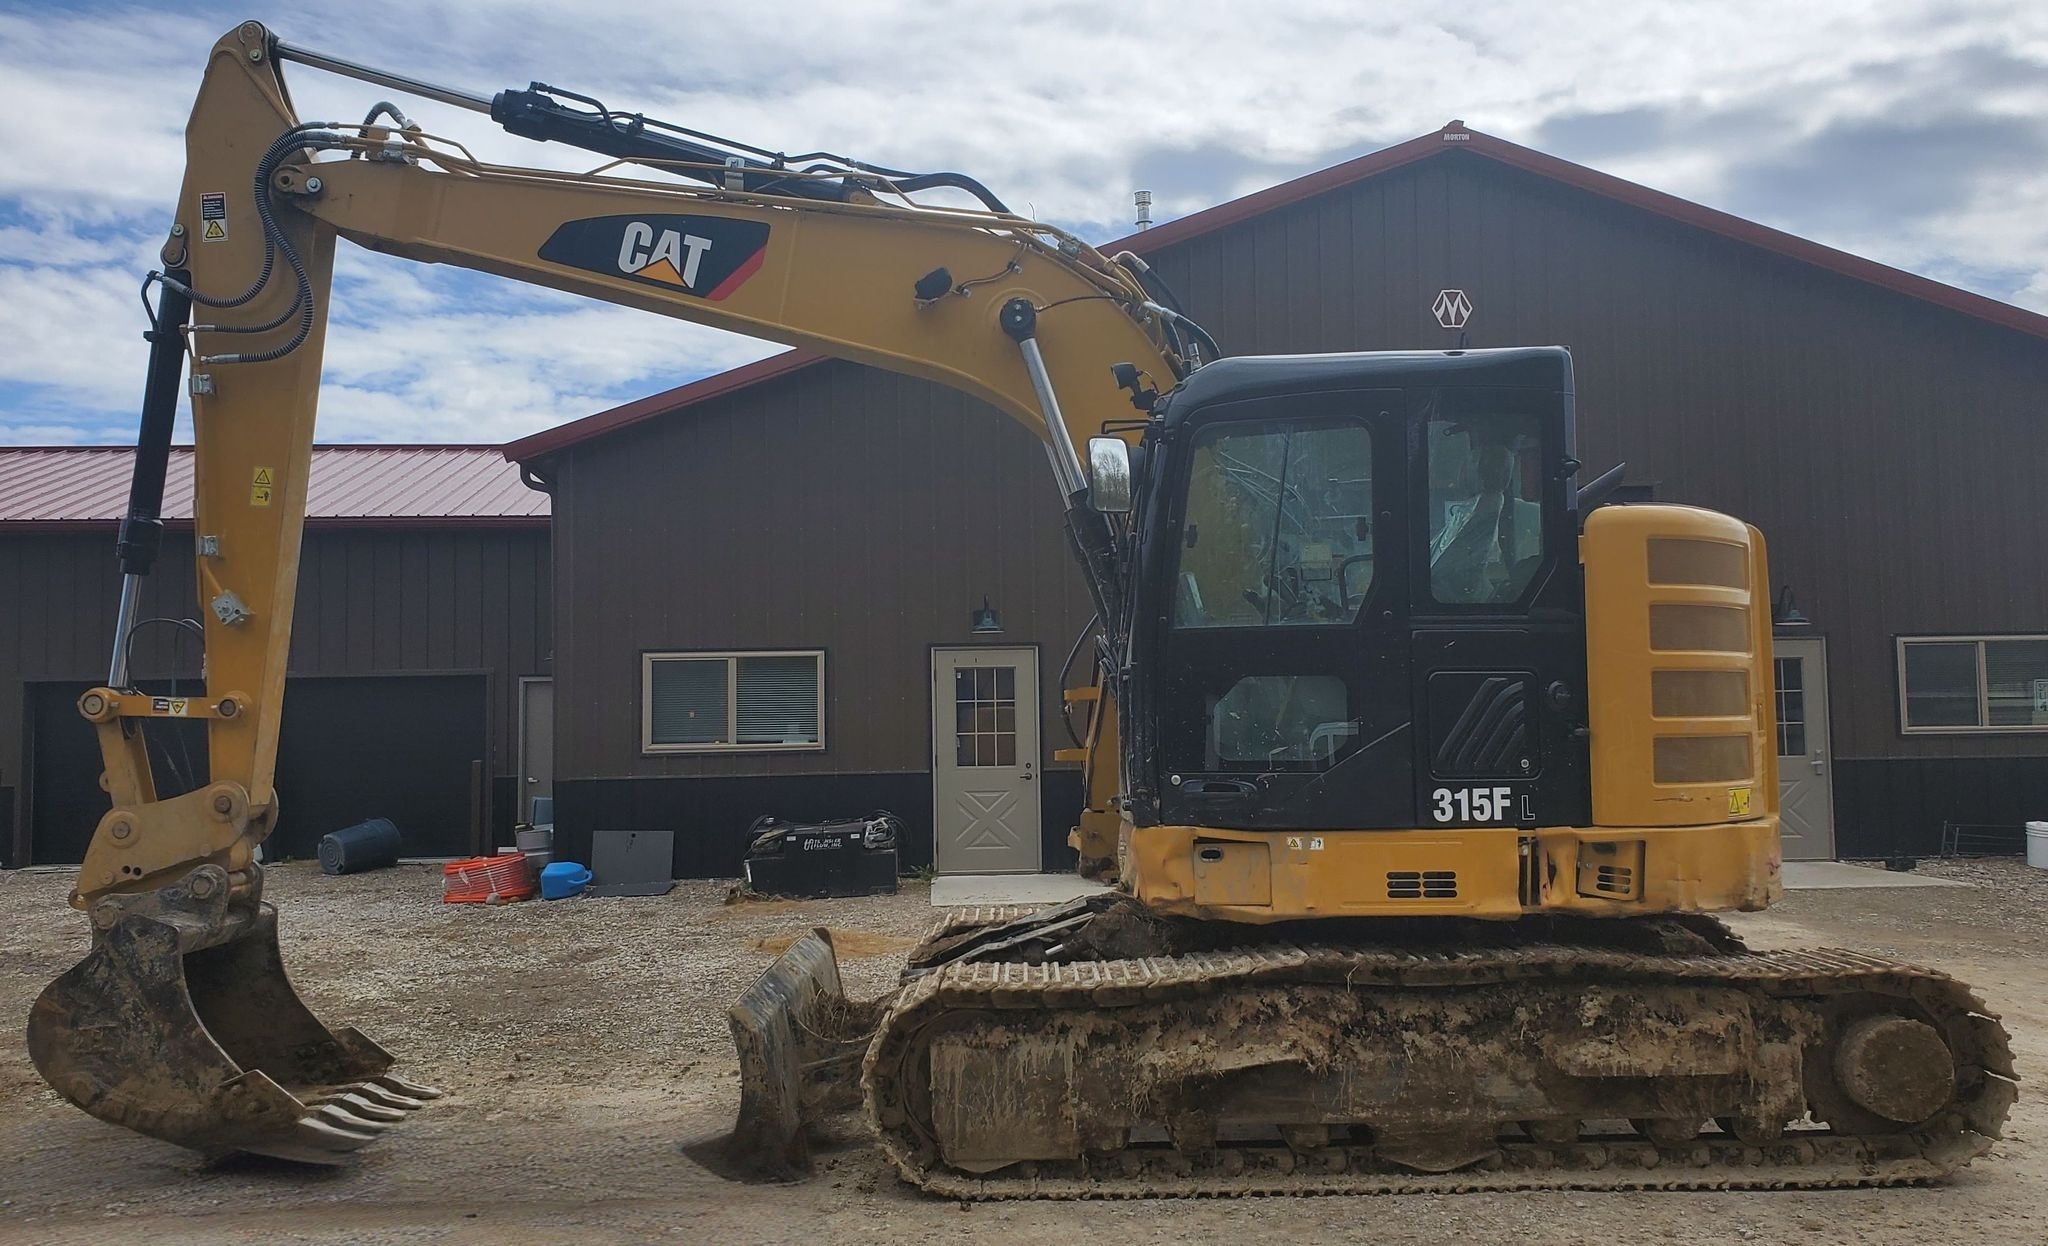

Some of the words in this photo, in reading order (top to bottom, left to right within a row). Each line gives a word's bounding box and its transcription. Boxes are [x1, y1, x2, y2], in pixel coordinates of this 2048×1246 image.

[1443, 133, 1470, 142] MORTON
[617, 221, 713, 289] CAT
[1432, 786, 1511, 822] 315F
[1521, 794, 1536, 821] L
